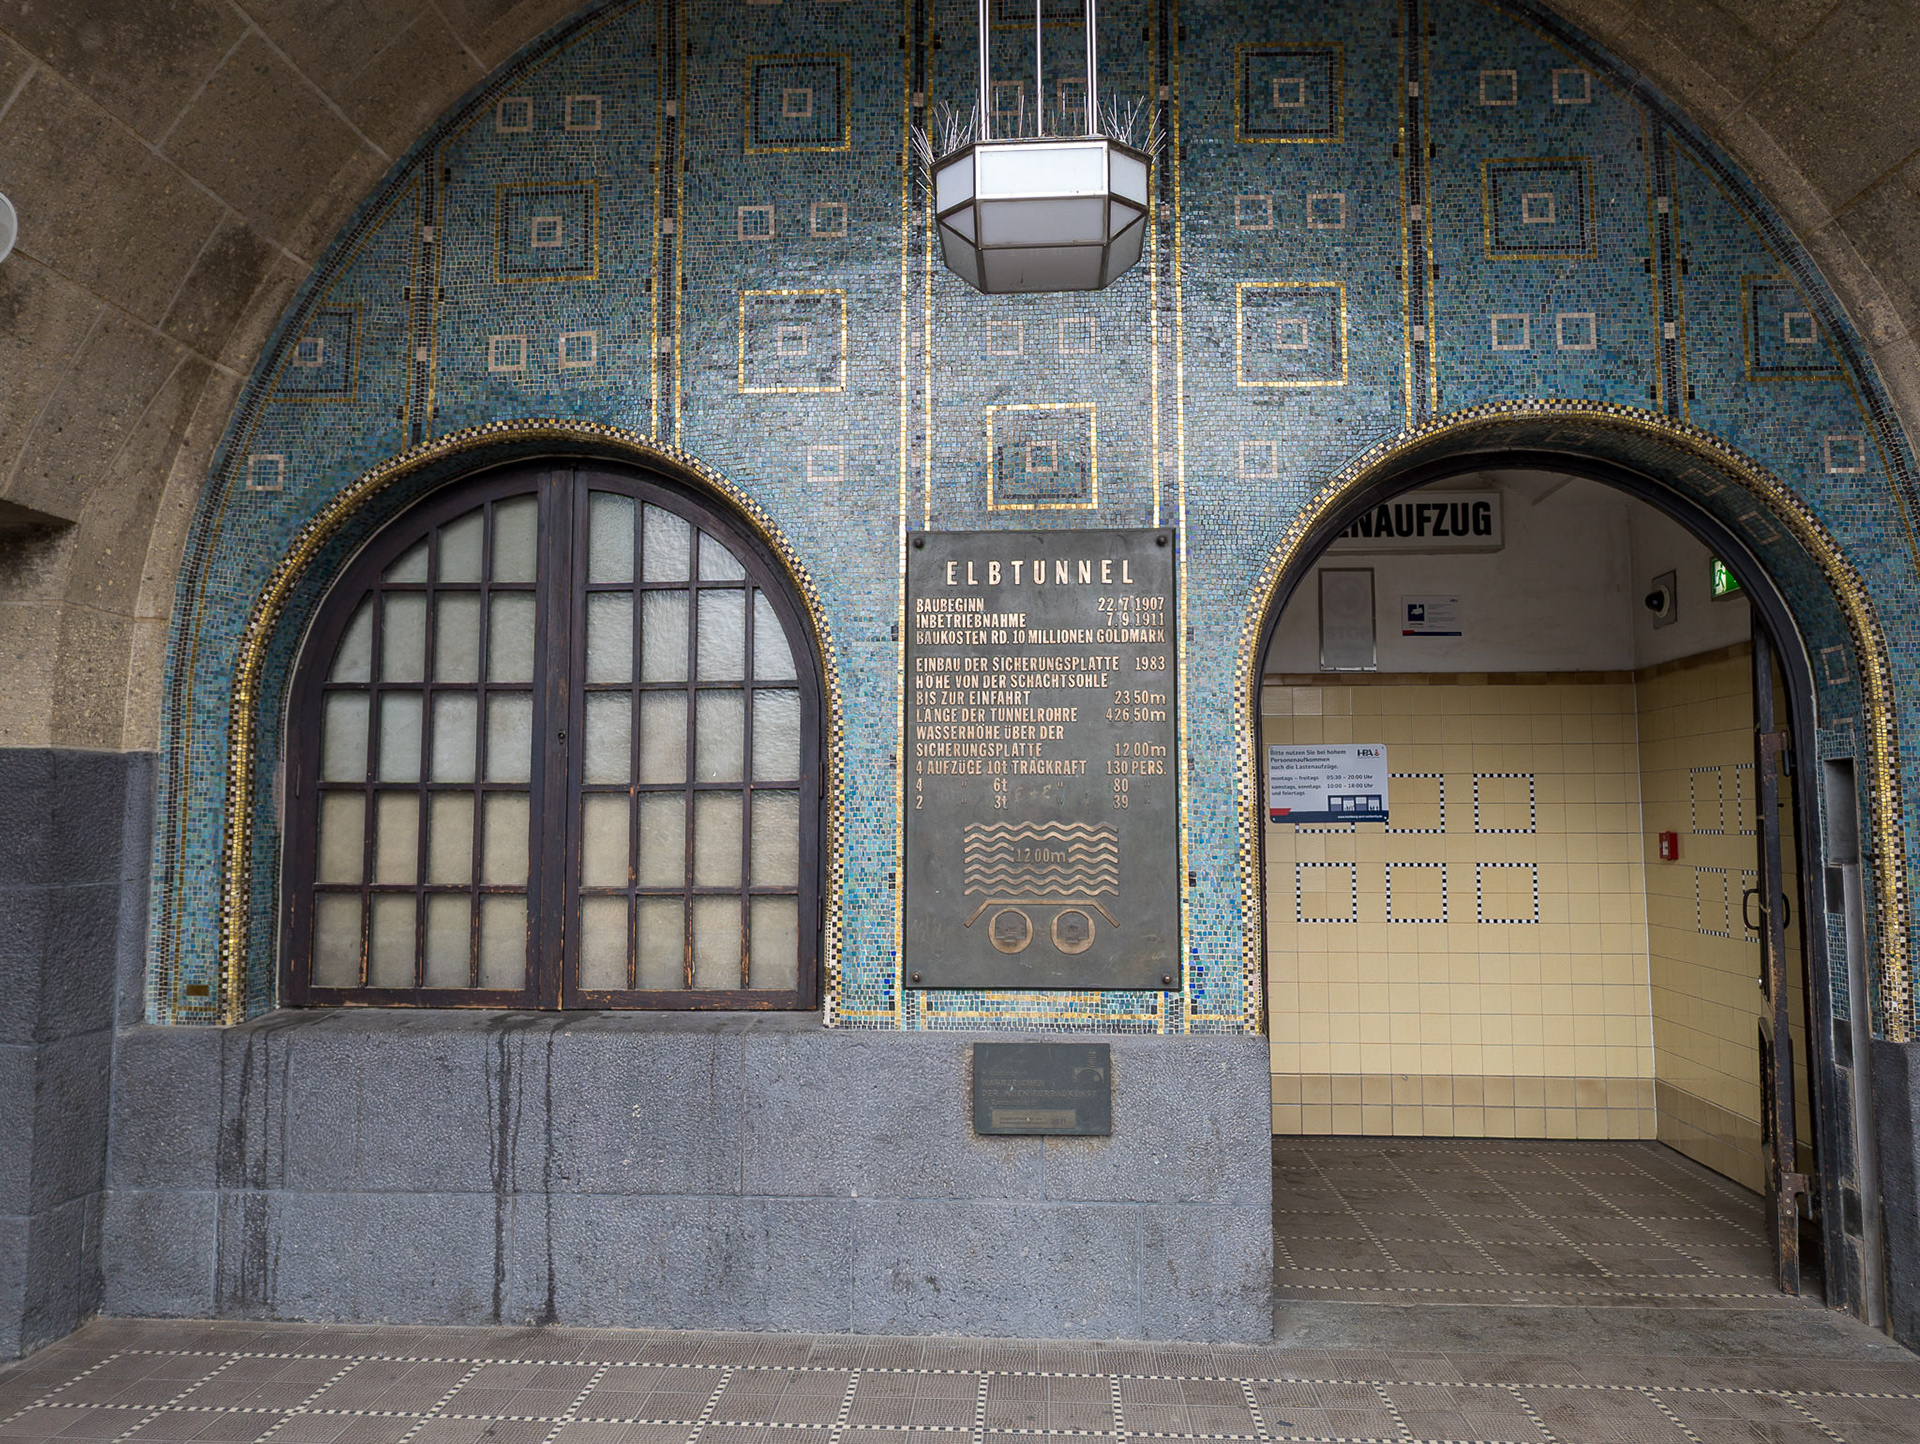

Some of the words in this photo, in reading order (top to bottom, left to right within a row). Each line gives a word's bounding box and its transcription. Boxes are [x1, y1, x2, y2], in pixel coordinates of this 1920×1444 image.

[1338, 501, 1492, 538] NAUFZUG
[946, 560, 1134, 585] ELBTUNNEL
[916, 598, 985, 613] BAUBEGINN
[916, 613, 1027, 628] INBETRIEBNAHME
[916, 630, 987, 645] BAUKOSTEN
[991, 630, 1010, 645] RD.
[1012, 629, 1026, 644] 10
[1028, 629, 1093, 644] MILLIONEN
[1096, 628, 1166, 644] GOLDMARK
[916, 657, 961, 672] EINBAU
[964, 657, 988, 672] DER
[992, 656, 1119, 672] SICHERUNGSPLATTE
[1135, 656, 1166, 671] 1983
[916, 672, 951, 689] HÖHE
[955, 674, 979, 689] VON
[983, 674, 1007, 688] DER
[1010, 673, 1108, 688] SCHACHTSOHLE
[916, 690, 936, 706] BIS
[941, 691, 964, 706] ZUR
[969, 690, 1031, 706] EINFAHRT
[916, 706, 957, 723] LÄNGE
[961, 708, 985, 723] DER
[990, 707, 1078, 722] TUNNELROHRE
[916, 723, 1000, 740] WASSERHÖHE
[1004, 725, 1036, 740] ÜBER
[1040, 725, 1064, 740] DER
[916, 742, 1042, 757] SICHERUNGSPLATTE
[916, 760, 924, 775] 4
[927, 760, 982, 775] AUFZÜGE
[1012, 760, 1087, 775] TRAGKRAFT
[1106, 760, 1128, 775] 130
[1131, 760, 1167, 775] PERS.
[916, 777, 924, 792] 4
[1113, 777, 1129, 792] 80
[916, 795, 924, 810] 2
[1112, 795, 1129, 810] 39
